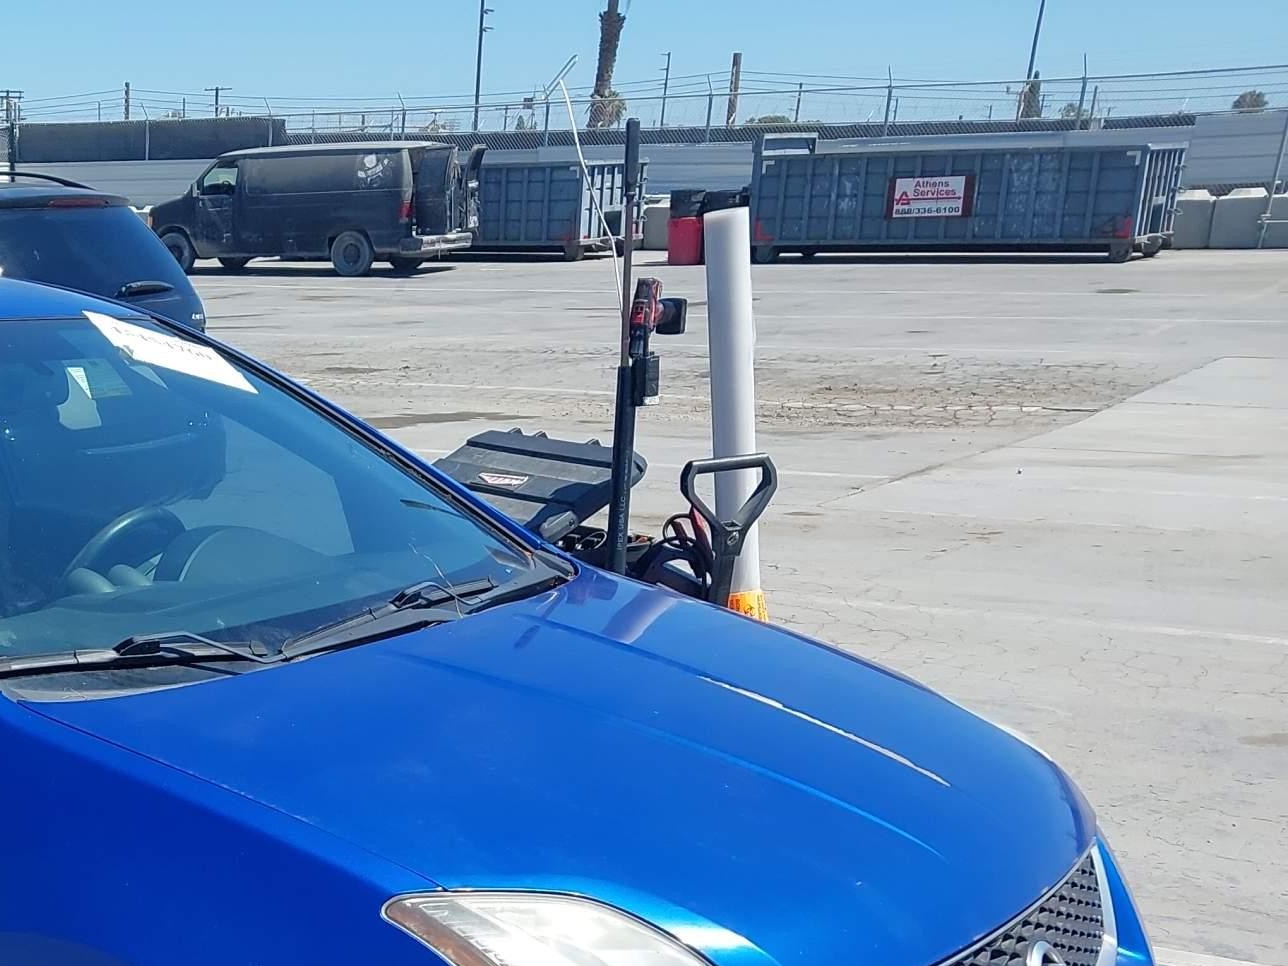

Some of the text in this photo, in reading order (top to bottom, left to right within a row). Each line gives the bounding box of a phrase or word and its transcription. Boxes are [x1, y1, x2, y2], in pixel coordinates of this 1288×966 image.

[914, 179, 950, 189] Athens
[912, 188, 957, 197] Services
[894, 206, 961, 215] 888/336-6100
